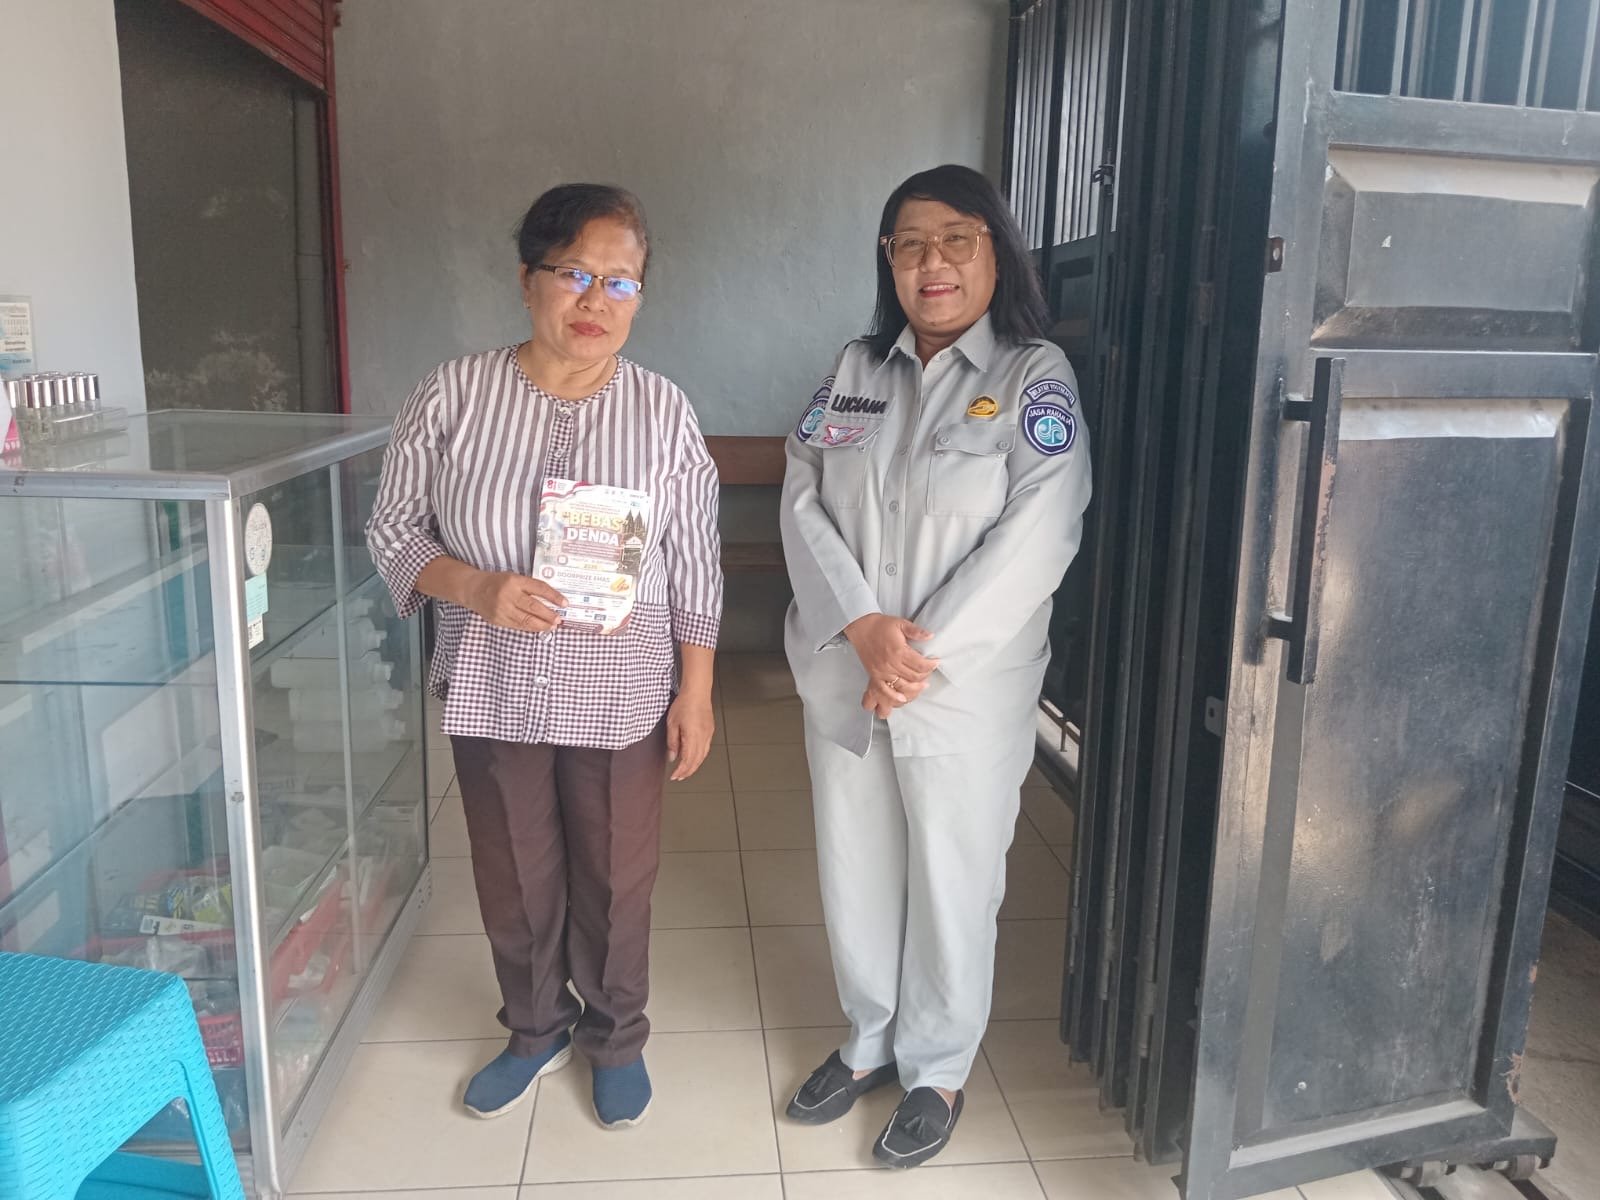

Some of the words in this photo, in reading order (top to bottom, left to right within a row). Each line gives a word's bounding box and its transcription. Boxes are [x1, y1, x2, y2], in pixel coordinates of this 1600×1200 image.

[831, 393, 888, 414] LUCIANA
[1029, 407, 1046, 417] JASA
[1046, 408, 1072, 426] RAHARJA
[566, 527, 619, 546] DENDA
